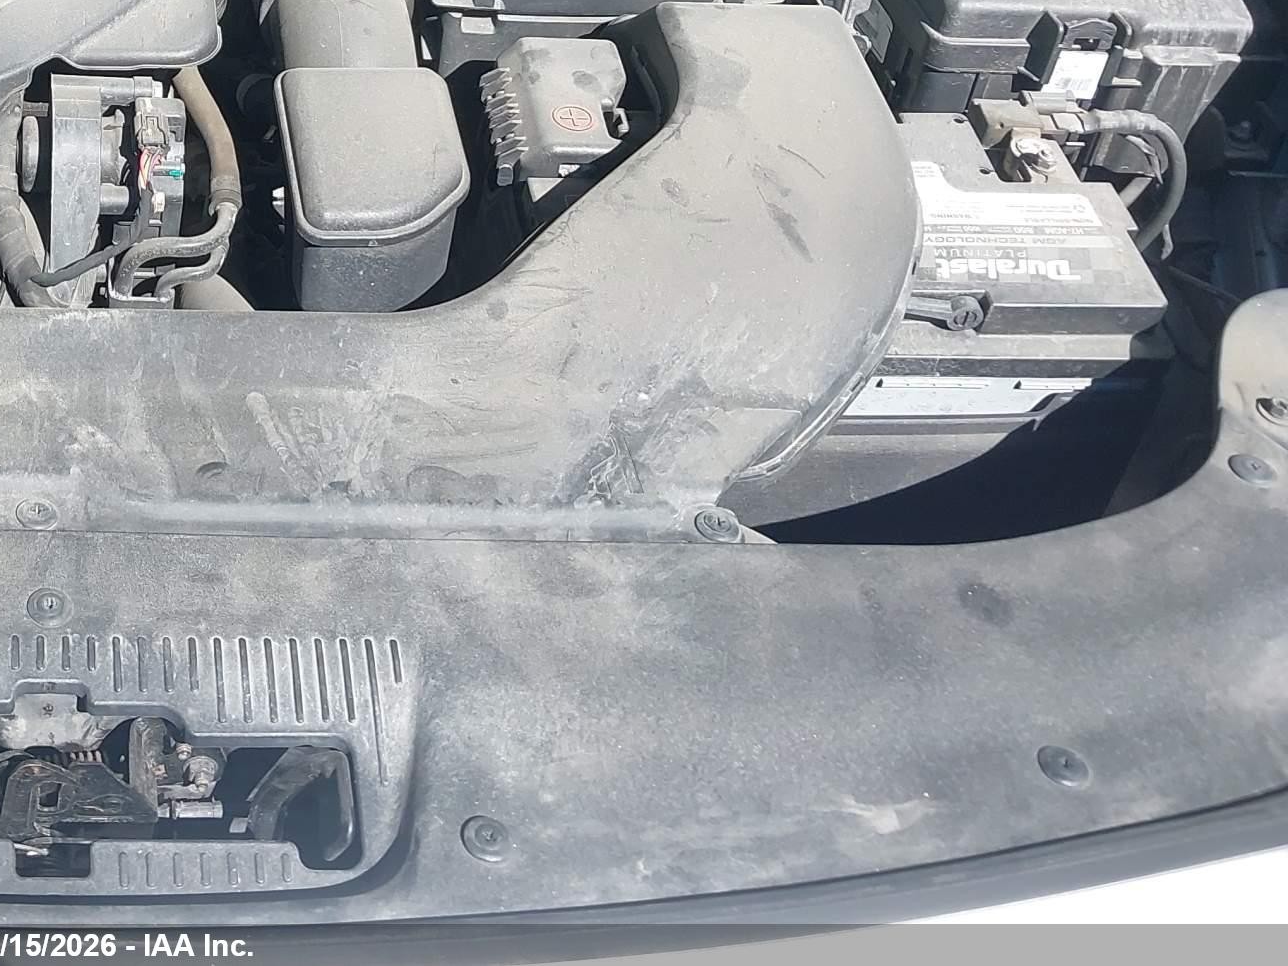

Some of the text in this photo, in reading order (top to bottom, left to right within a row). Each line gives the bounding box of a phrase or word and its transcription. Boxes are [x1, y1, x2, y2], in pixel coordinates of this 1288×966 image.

[924, 236, 1067, 245] AGM TECHNOLOGY
[934, 248, 1028, 258] PLATINUM
[935, 257, 1082, 281] Duralast
